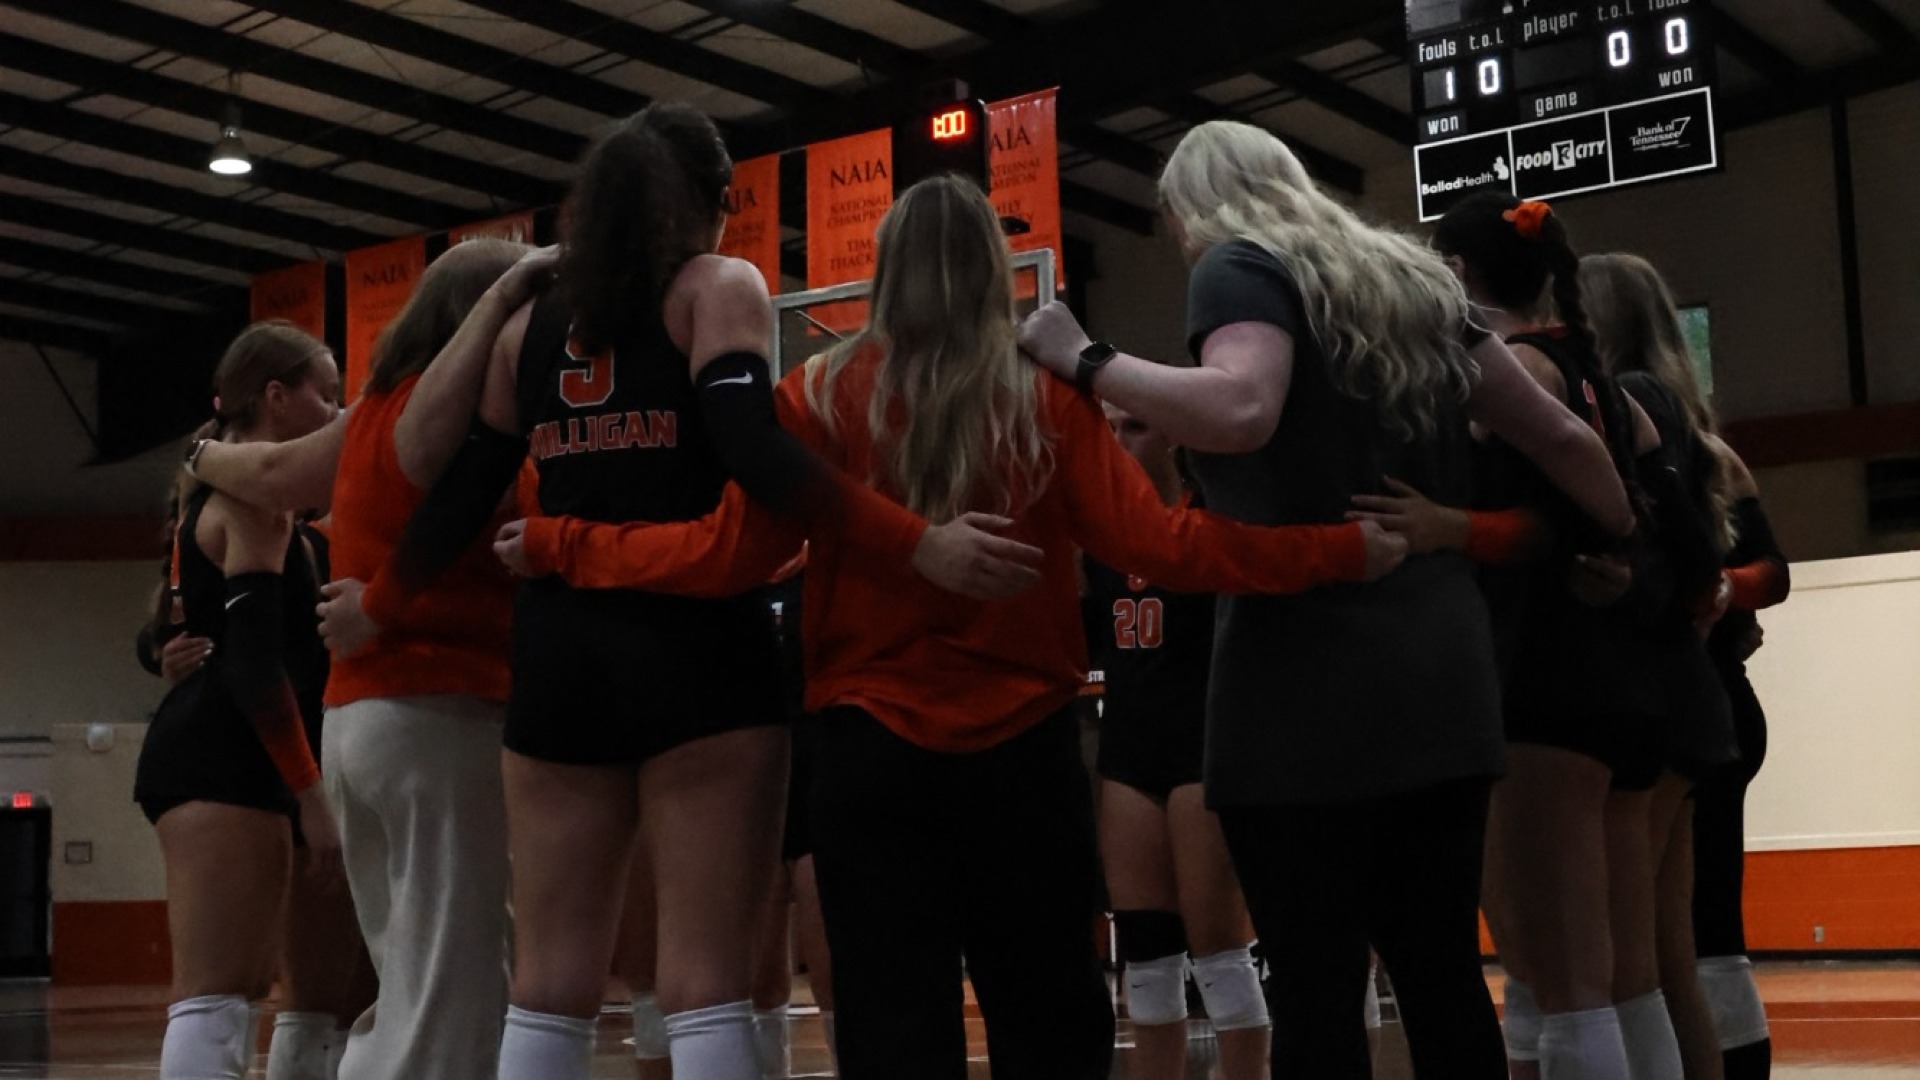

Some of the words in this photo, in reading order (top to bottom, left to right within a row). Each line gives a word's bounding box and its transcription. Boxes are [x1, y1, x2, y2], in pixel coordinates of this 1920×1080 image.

[1523, 11, 1578, 42] player
[1664, 17, 1689, 55] 0
[1419, 38, 1457, 62] fouls
[1608, 30, 1631, 67] 0
[1445, 70, 1455, 101] 1
[1478, 58, 1500, 95] 0
[1658, 66, 1693, 88] won
[1535, 91, 1578, 117] game
[987, 124, 1032, 152] AIA
[1427, 115, 1459, 135] won
[1516, 150, 1552, 171] FOOD
[1575, 140, 1605, 159] CITY
[829, 158, 888, 189] NAIA
[829, 252, 874, 271] THACK
[1113, 597, 1164, 649] 20
